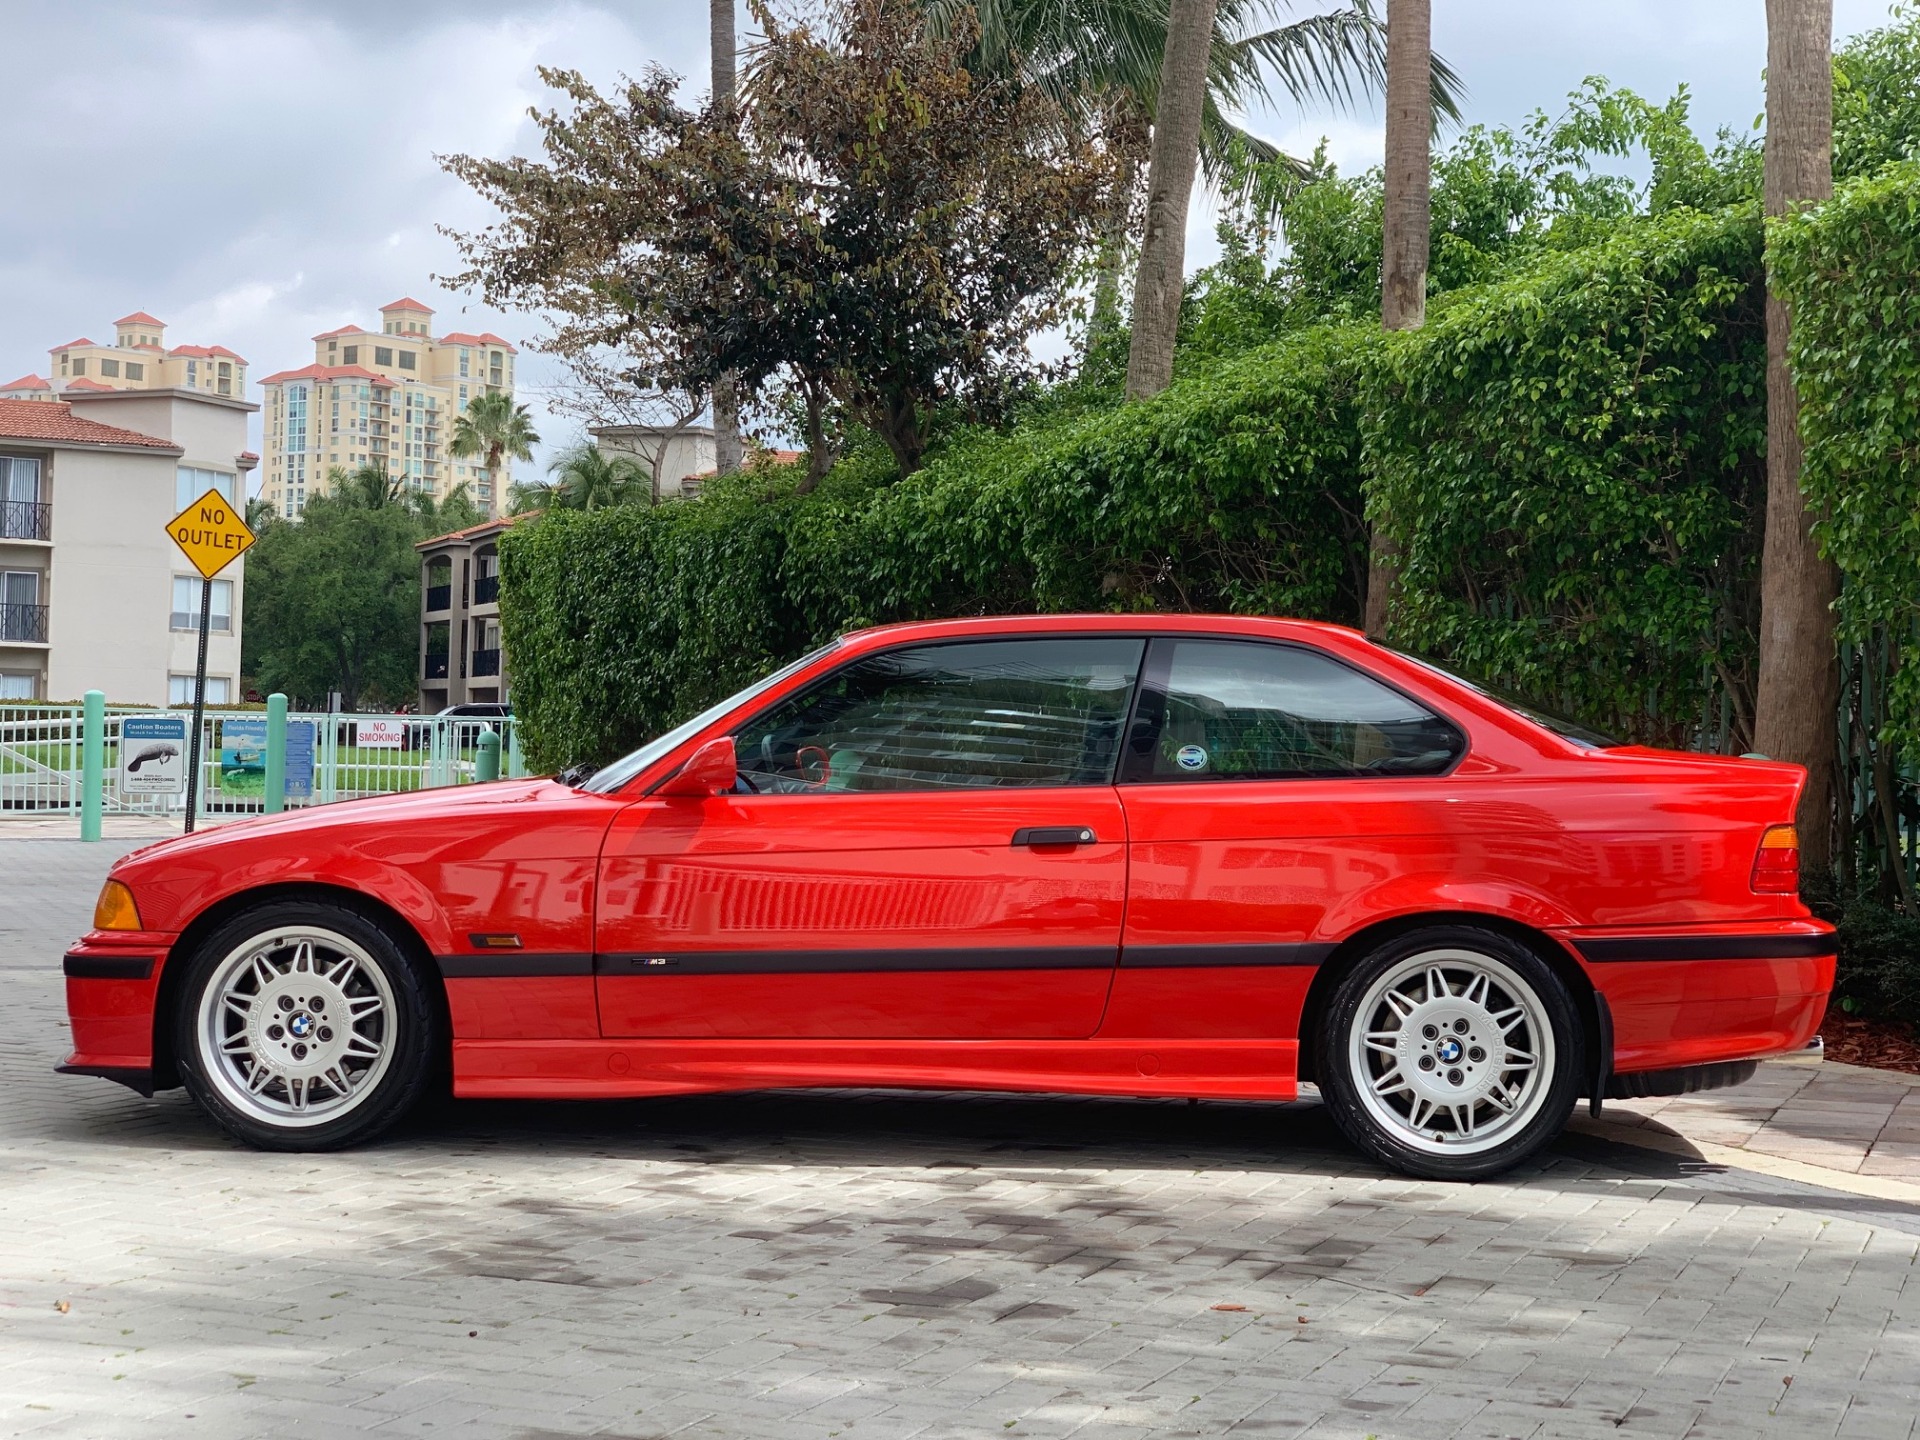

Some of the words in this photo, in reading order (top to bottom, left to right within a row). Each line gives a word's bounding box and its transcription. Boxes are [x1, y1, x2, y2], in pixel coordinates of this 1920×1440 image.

[200, 507, 225, 525] NO
[178, 528, 245, 550] OUTLET
[358, 733, 400, 742] SMOKING
[373, 722, 386, 732] NO
[249, 997, 288, 1075] MOTORSPORT
[1399, 1030, 1410, 1059] BMW
[1476, 1013, 1503, 1093] MOTORSPORT
